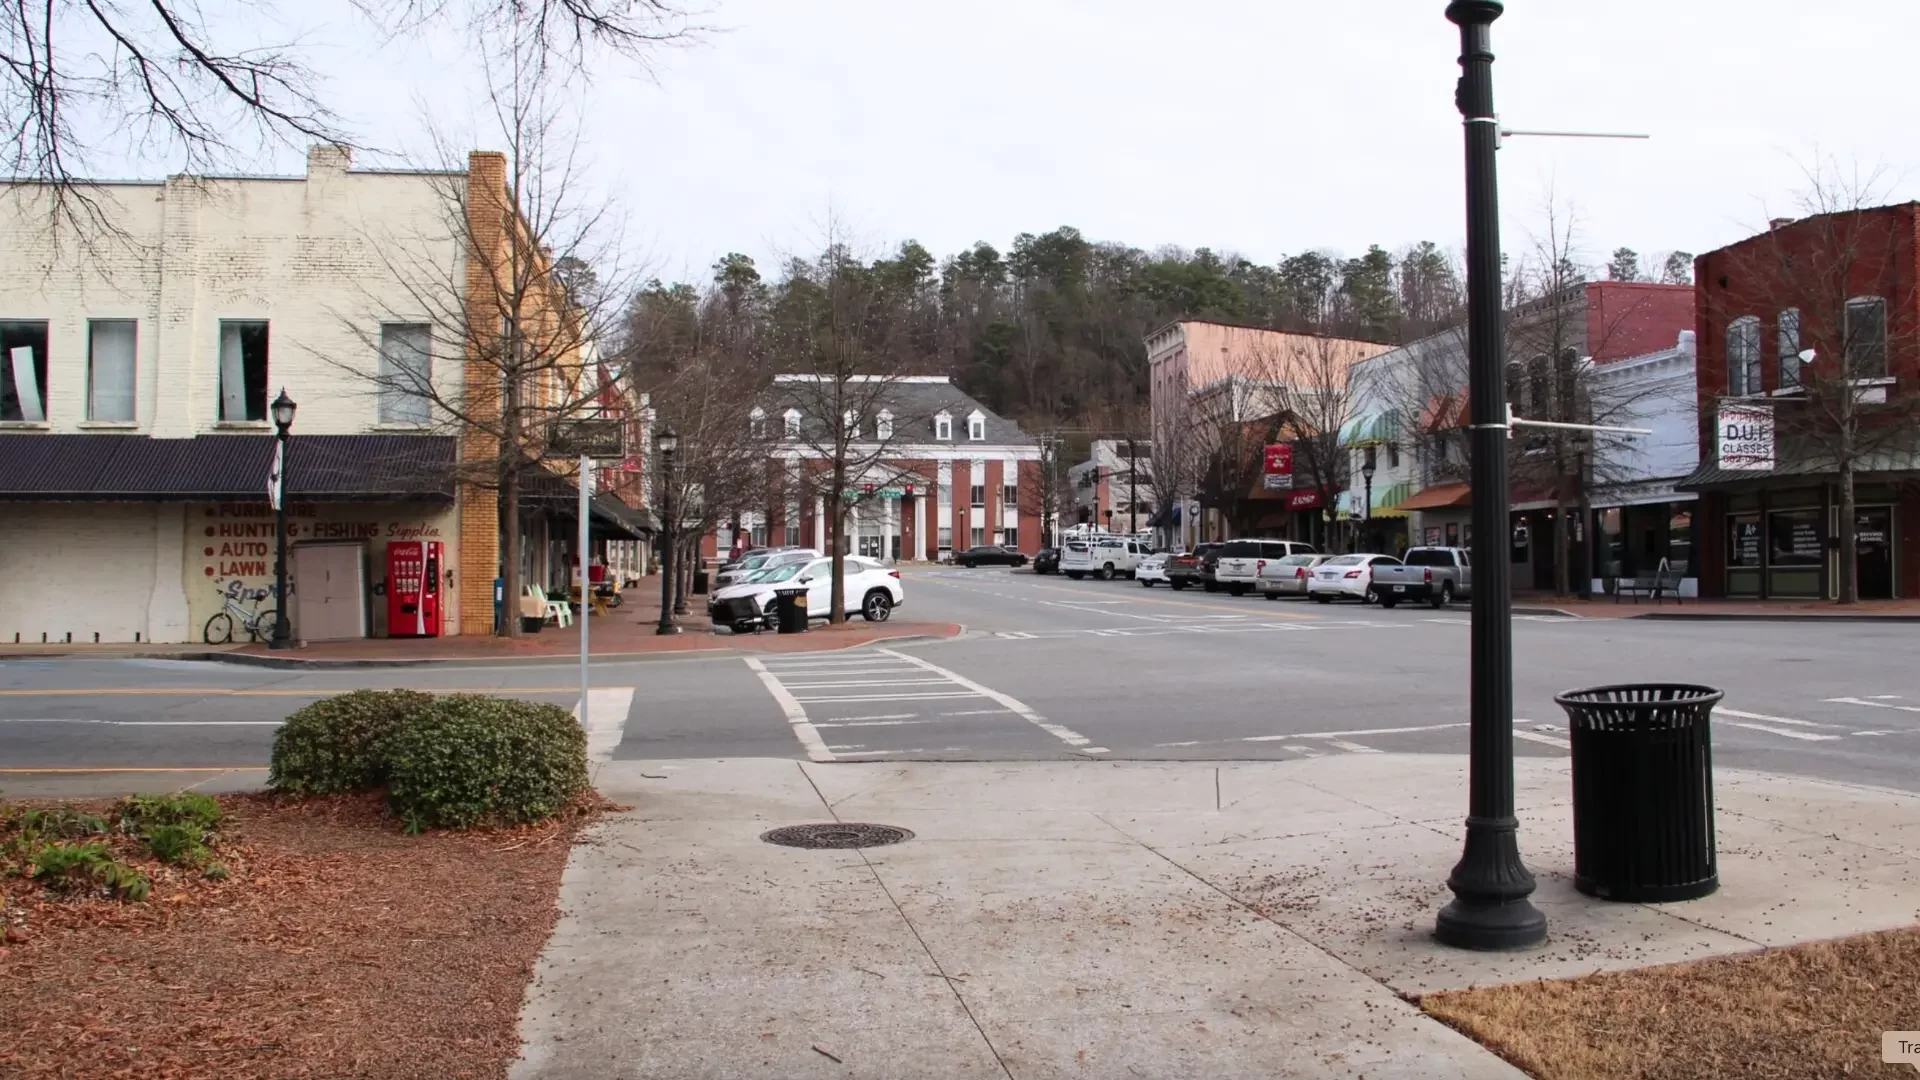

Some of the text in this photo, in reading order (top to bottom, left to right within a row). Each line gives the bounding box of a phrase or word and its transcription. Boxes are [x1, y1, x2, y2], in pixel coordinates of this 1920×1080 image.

[1722, 444, 1769, 454] CLASSES
[220, 503, 316, 517] FURNIURE
[219, 523, 299, 537] HUNTIG
[314, 523, 379, 537] FISHING
[219, 542, 267, 556] AUTO
[220, 562, 266, 576] LAWN
